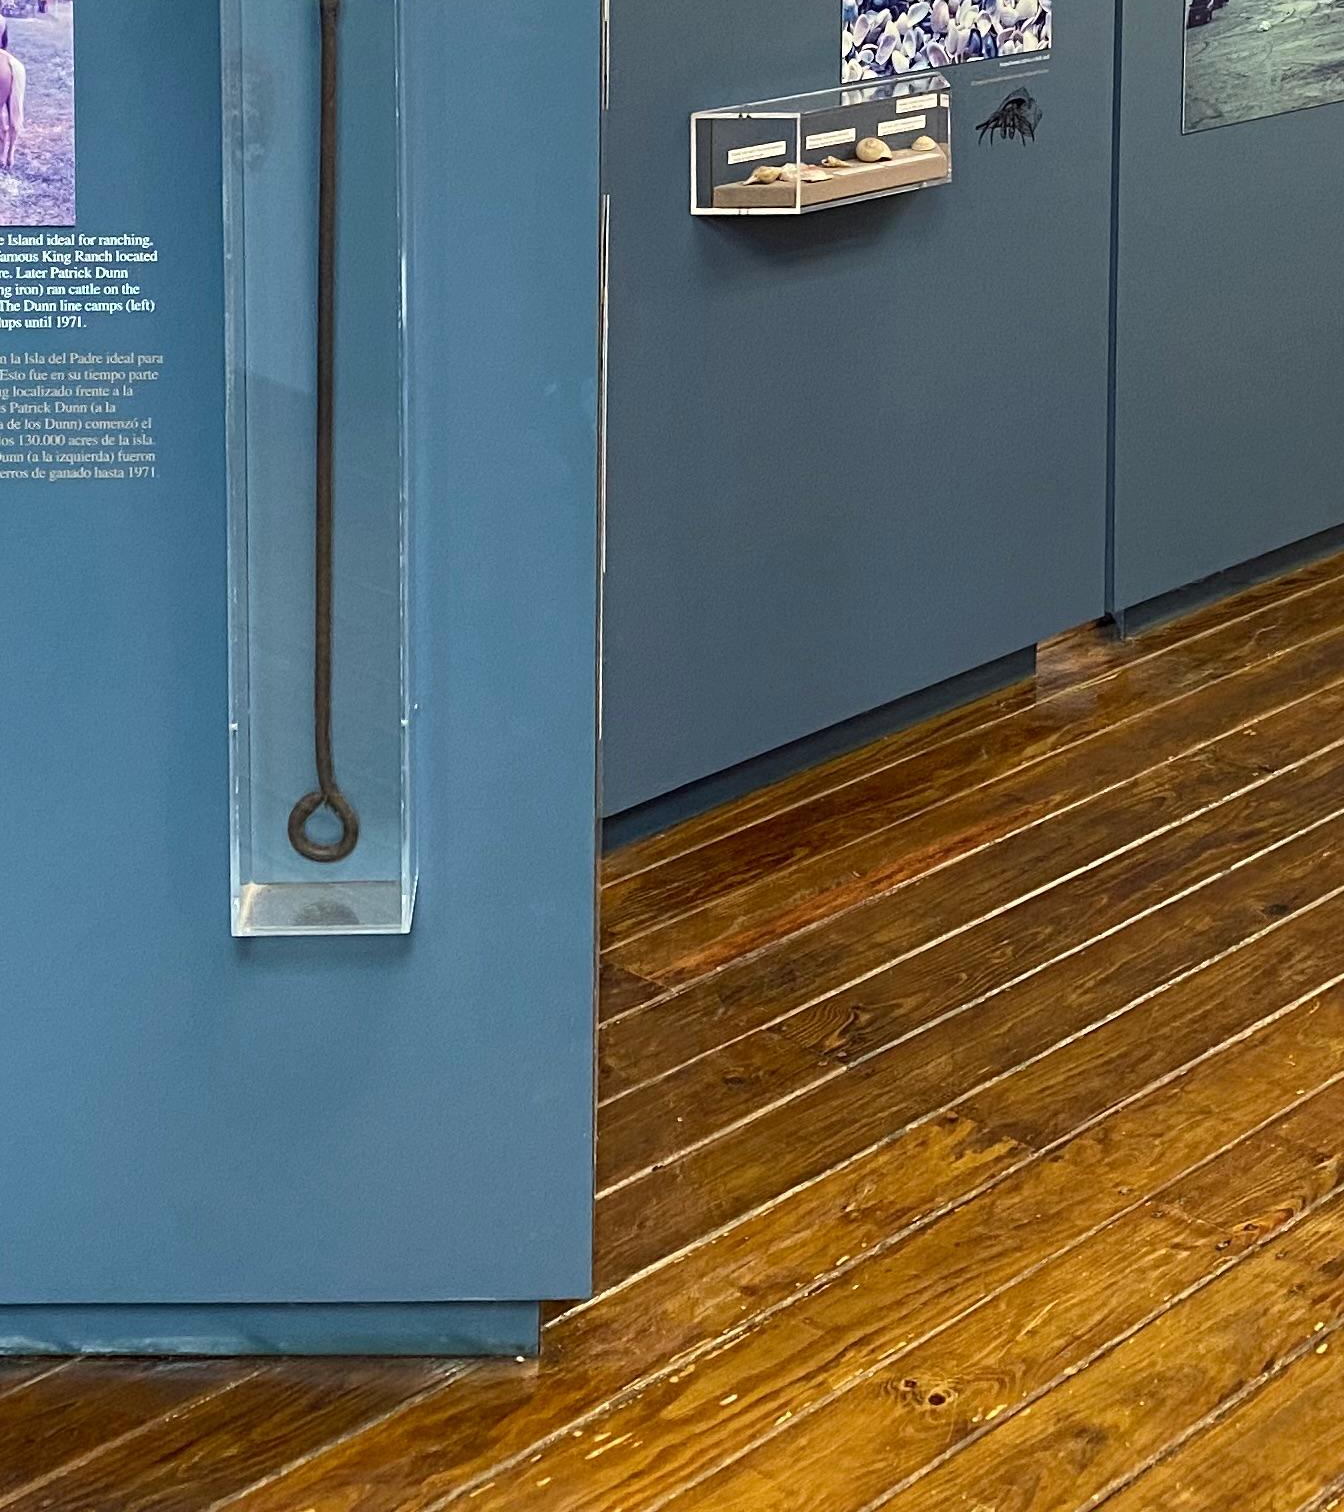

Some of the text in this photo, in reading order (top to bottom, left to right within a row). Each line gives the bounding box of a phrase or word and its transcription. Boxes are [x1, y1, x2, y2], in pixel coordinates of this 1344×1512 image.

[8, 234, 43, 245] Island
[47, 234, 74, 245] ideal
[79, 234, 96, 245] for
[99, 234, 153, 248] ranching.
[11, 353, 21, 364] la
[25, 353, 45, 364] Isla
[48, 353, 66, 364] del
[70, 353, 102, 363] Padre
[107, 353, 134, 363] ideal
[138, 355, 163, 367] para
